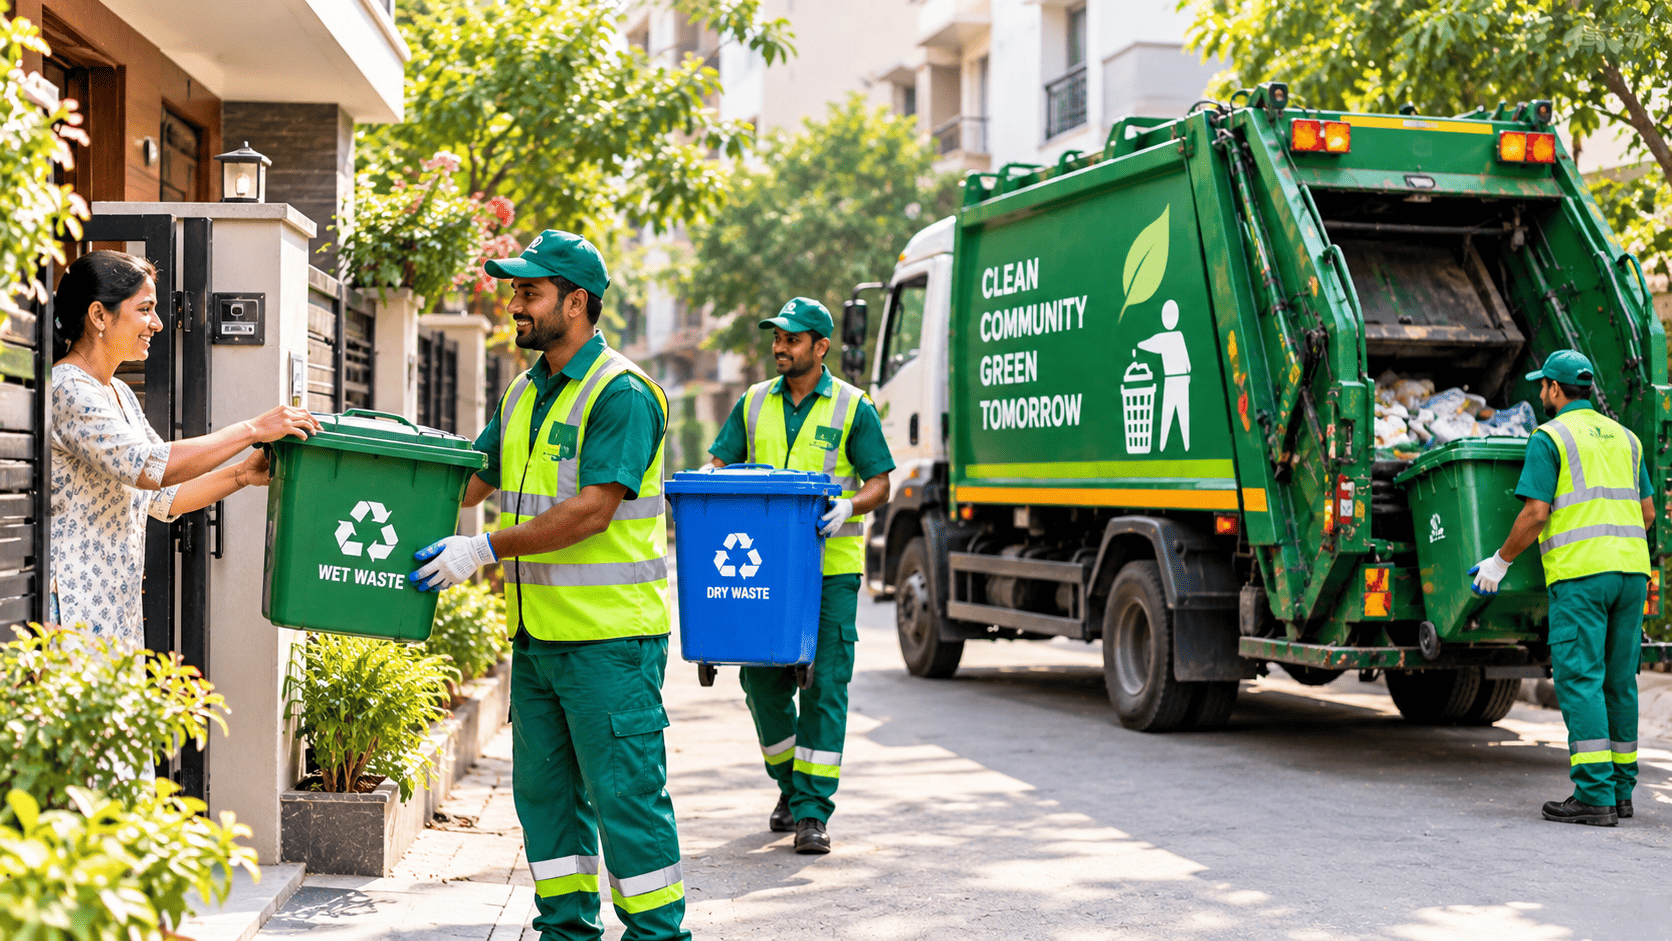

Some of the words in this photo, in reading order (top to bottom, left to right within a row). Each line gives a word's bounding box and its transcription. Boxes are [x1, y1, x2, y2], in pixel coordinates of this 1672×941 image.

[981, 257, 1039, 300] CLEAN
[979, 295, 1088, 343] COMMUNITY
[979, 350, 1038, 387] GREEN
[979, 393, 1083, 431] TOMORROW
[318, 563, 351, 583] WET
[354, 568, 406, 590] WASTE
[706, 586, 729, 599] DRY
[731, 586, 770, 600] WASTE
